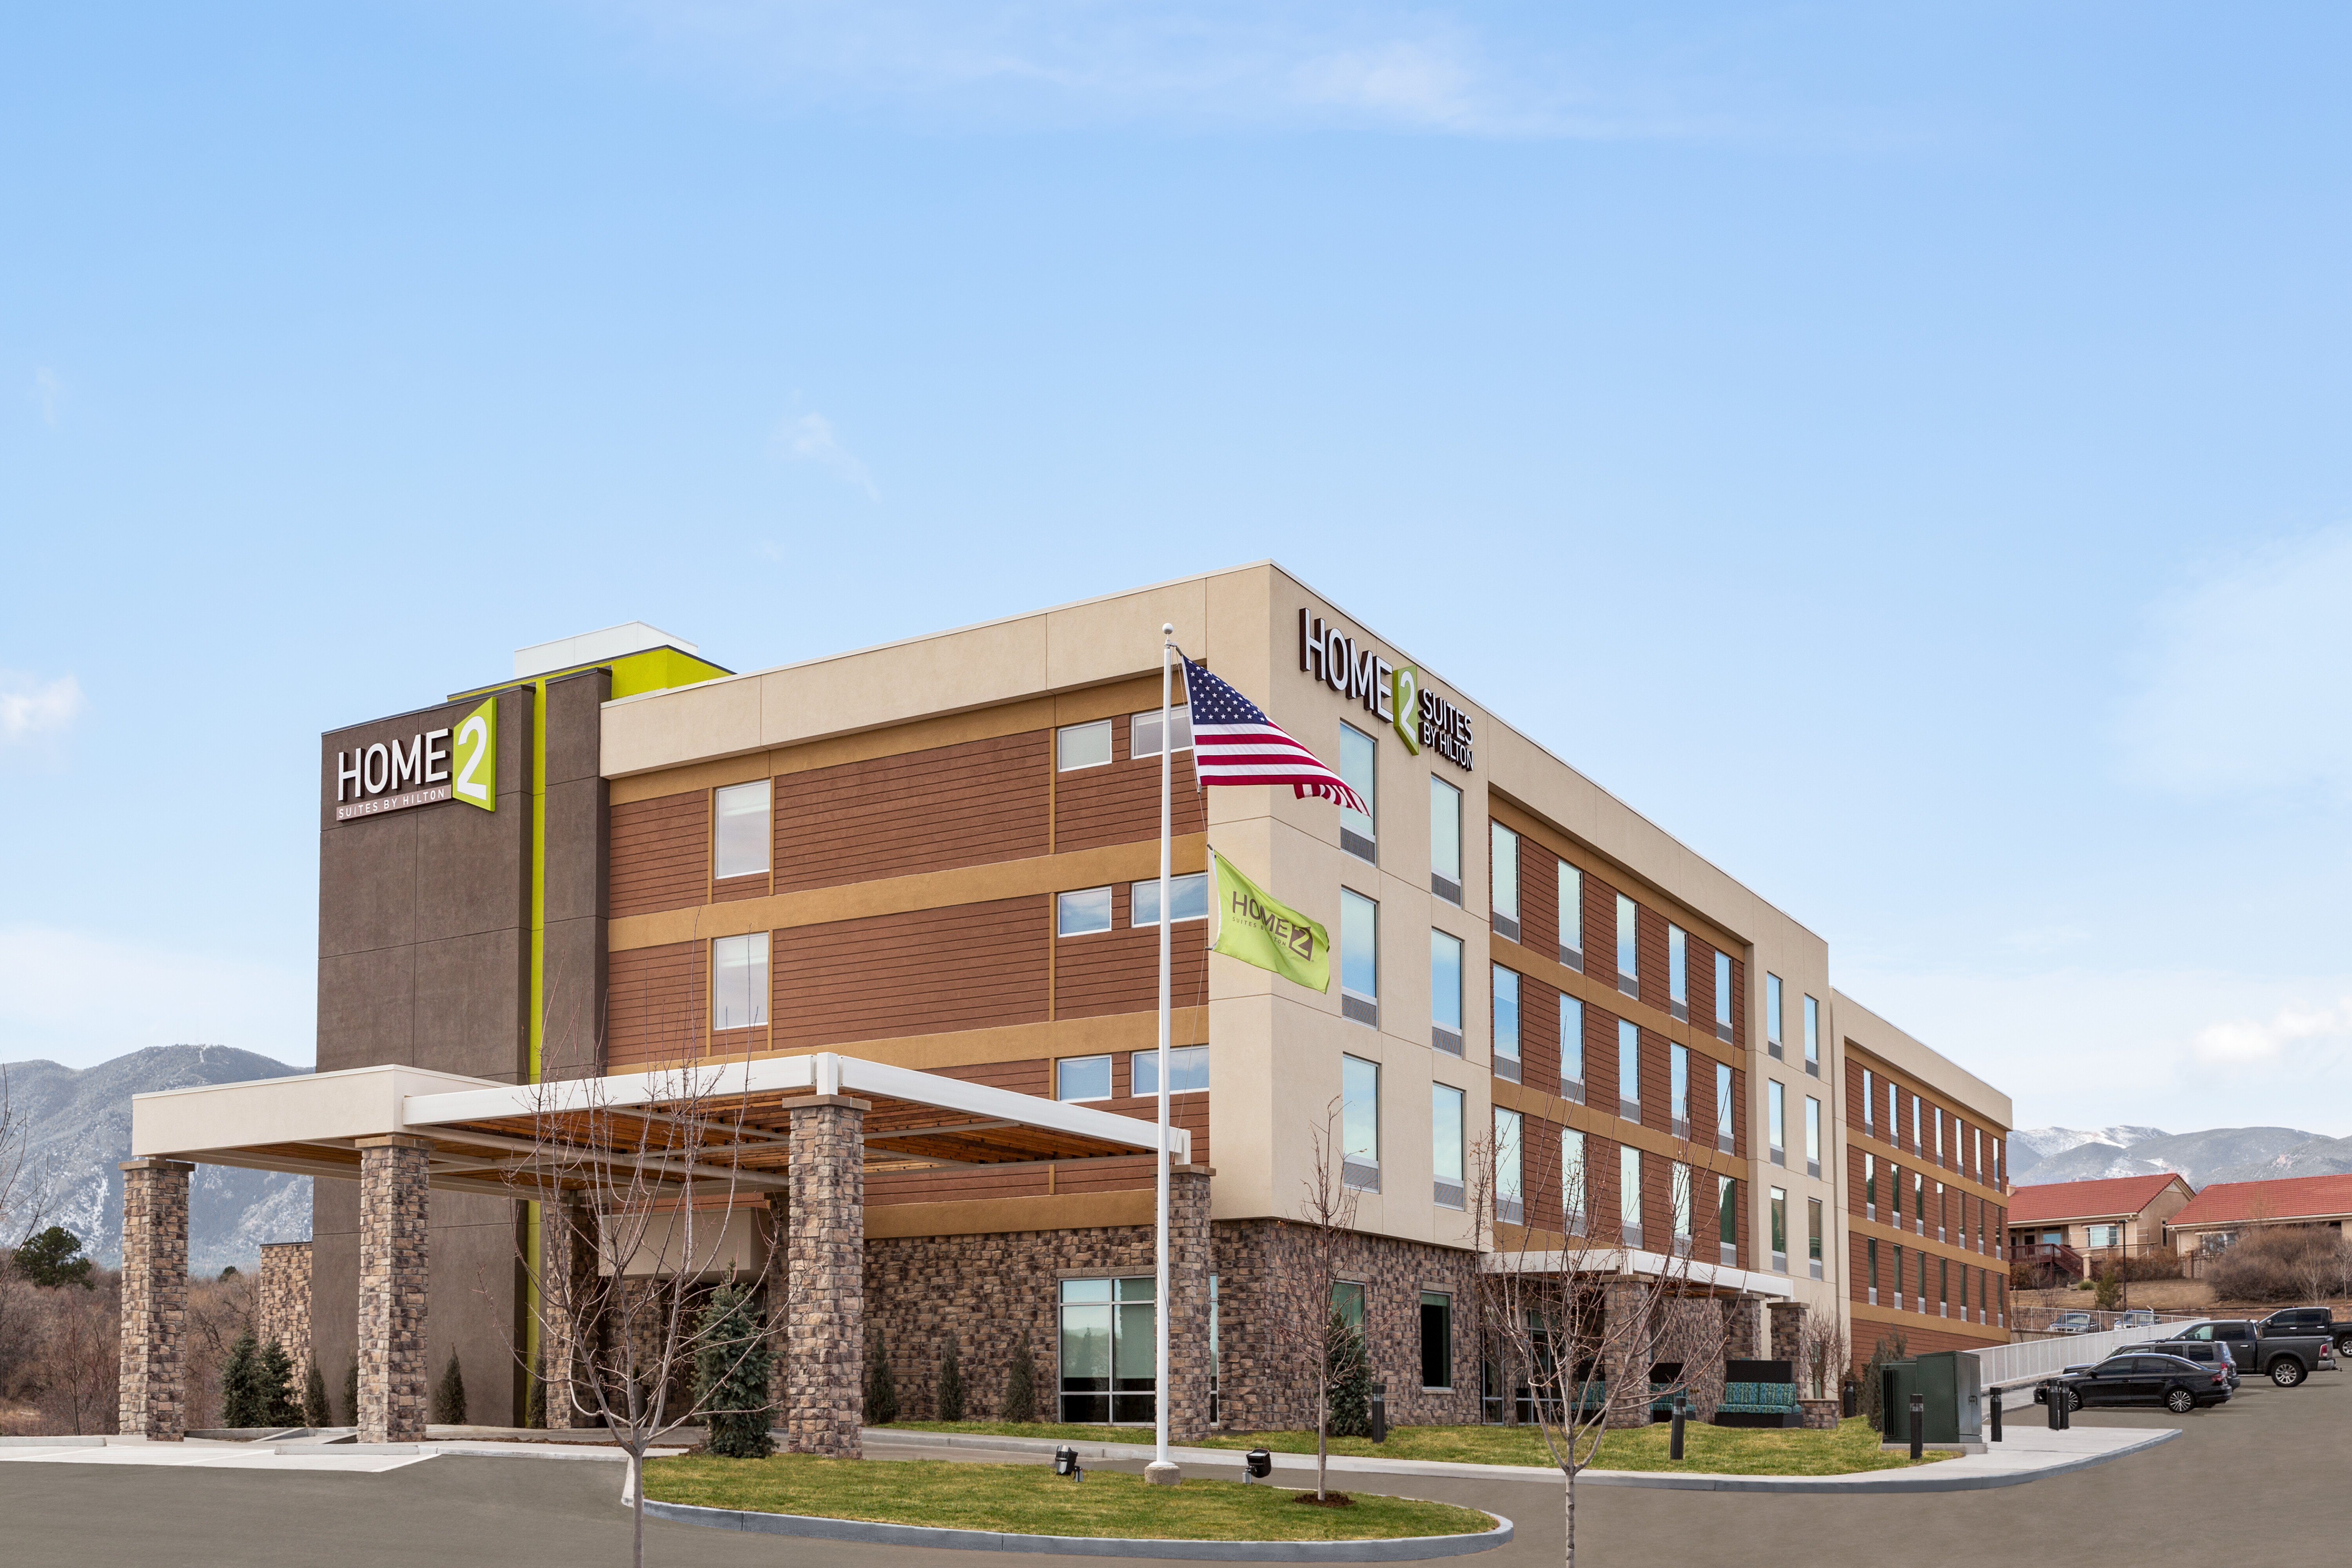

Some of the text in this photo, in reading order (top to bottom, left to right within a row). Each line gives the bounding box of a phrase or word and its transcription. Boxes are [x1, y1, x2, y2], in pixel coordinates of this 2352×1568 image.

[1300, 608, 1417, 744] HOME 2
[1421, 688, 1474, 745] SUITES
[338, 715, 487, 801] HOME 2
[1422, 721, 1474, 771] BY HILTON
[339, 788, 445, 818] SUITES BY HILTON
[1232, 891, 1289, 939] HOME
[1232, 916, 1257, 928] SUITES
